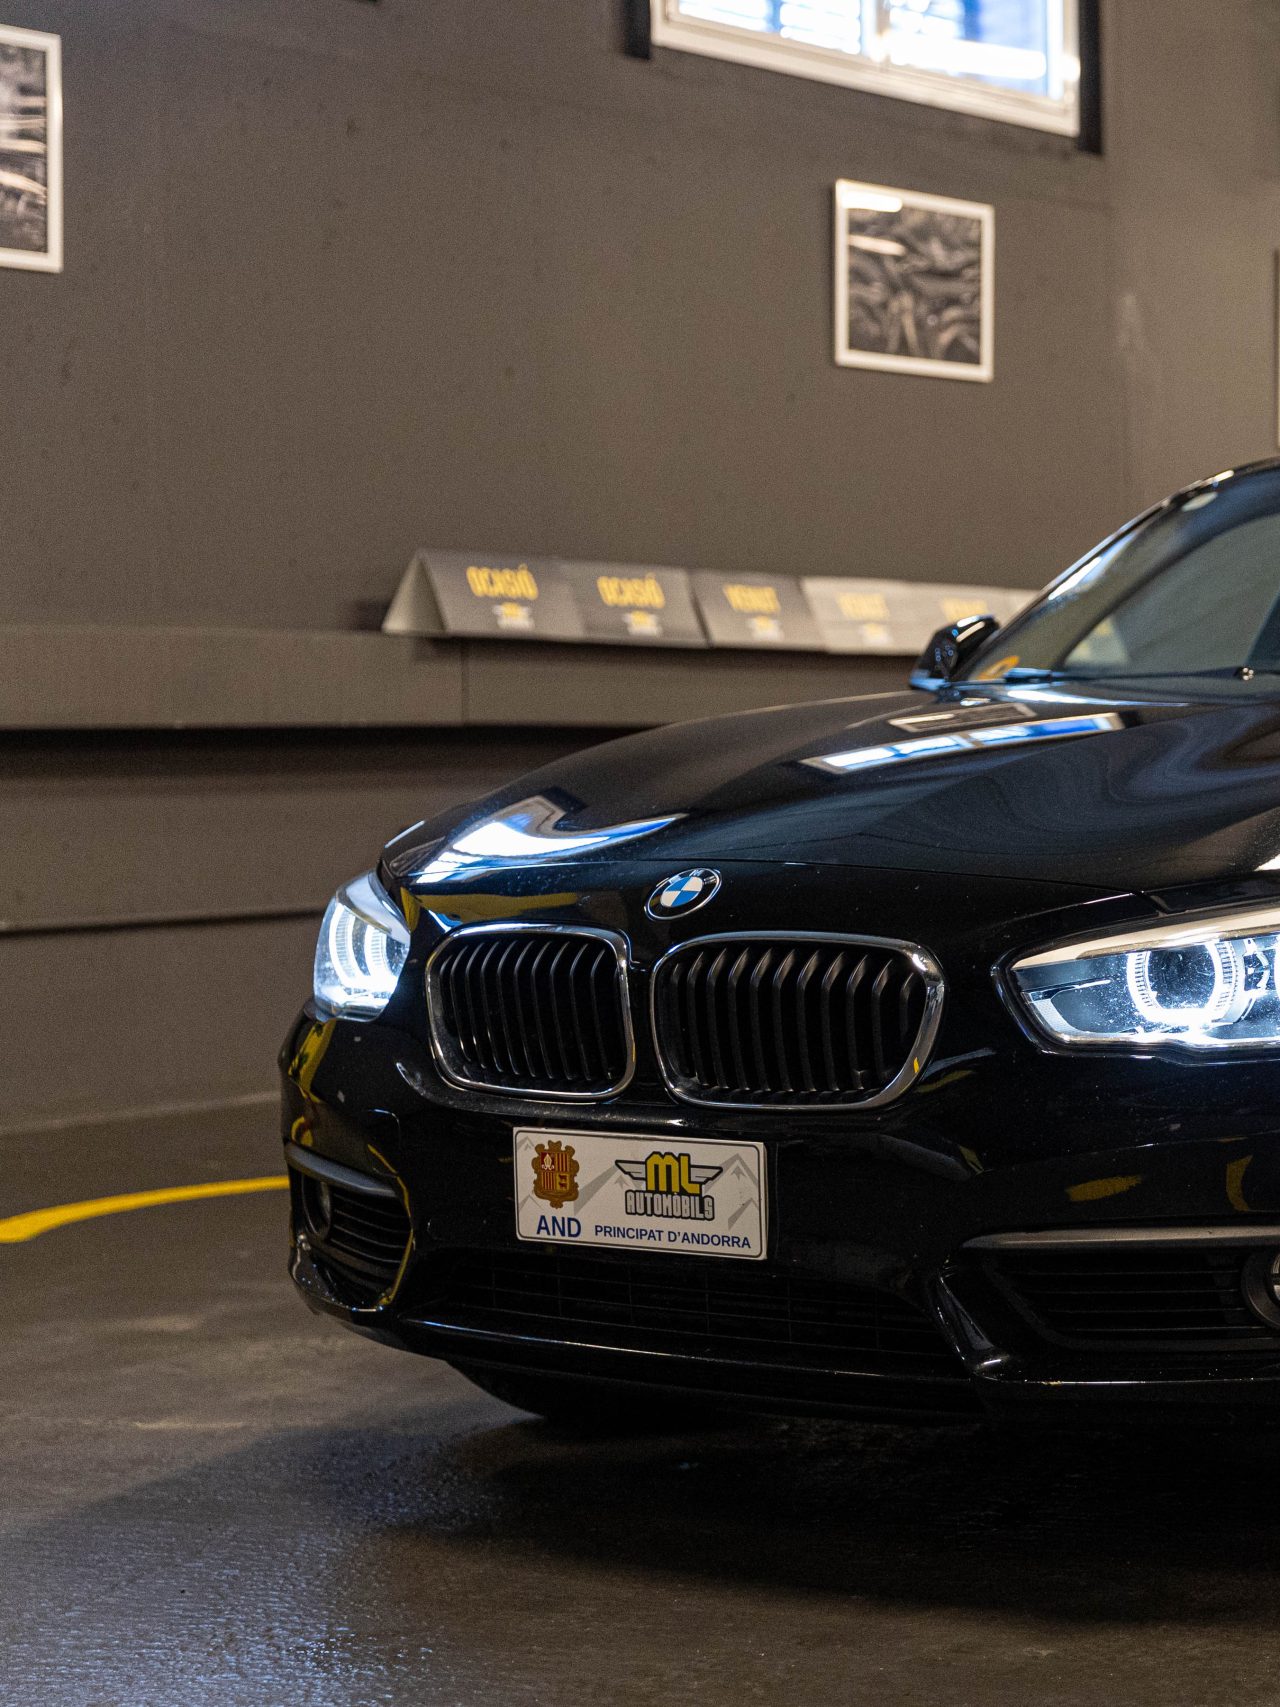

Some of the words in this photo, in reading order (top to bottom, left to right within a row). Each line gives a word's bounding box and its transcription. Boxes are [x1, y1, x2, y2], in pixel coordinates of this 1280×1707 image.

[645, 1151, 702, 1194] ML
[536, 1214, 582, 1238] AND
[594, 1224, 665, 1242] PRINCIPAT
[668, 1230, 751, 1249] D'ANDORRA
